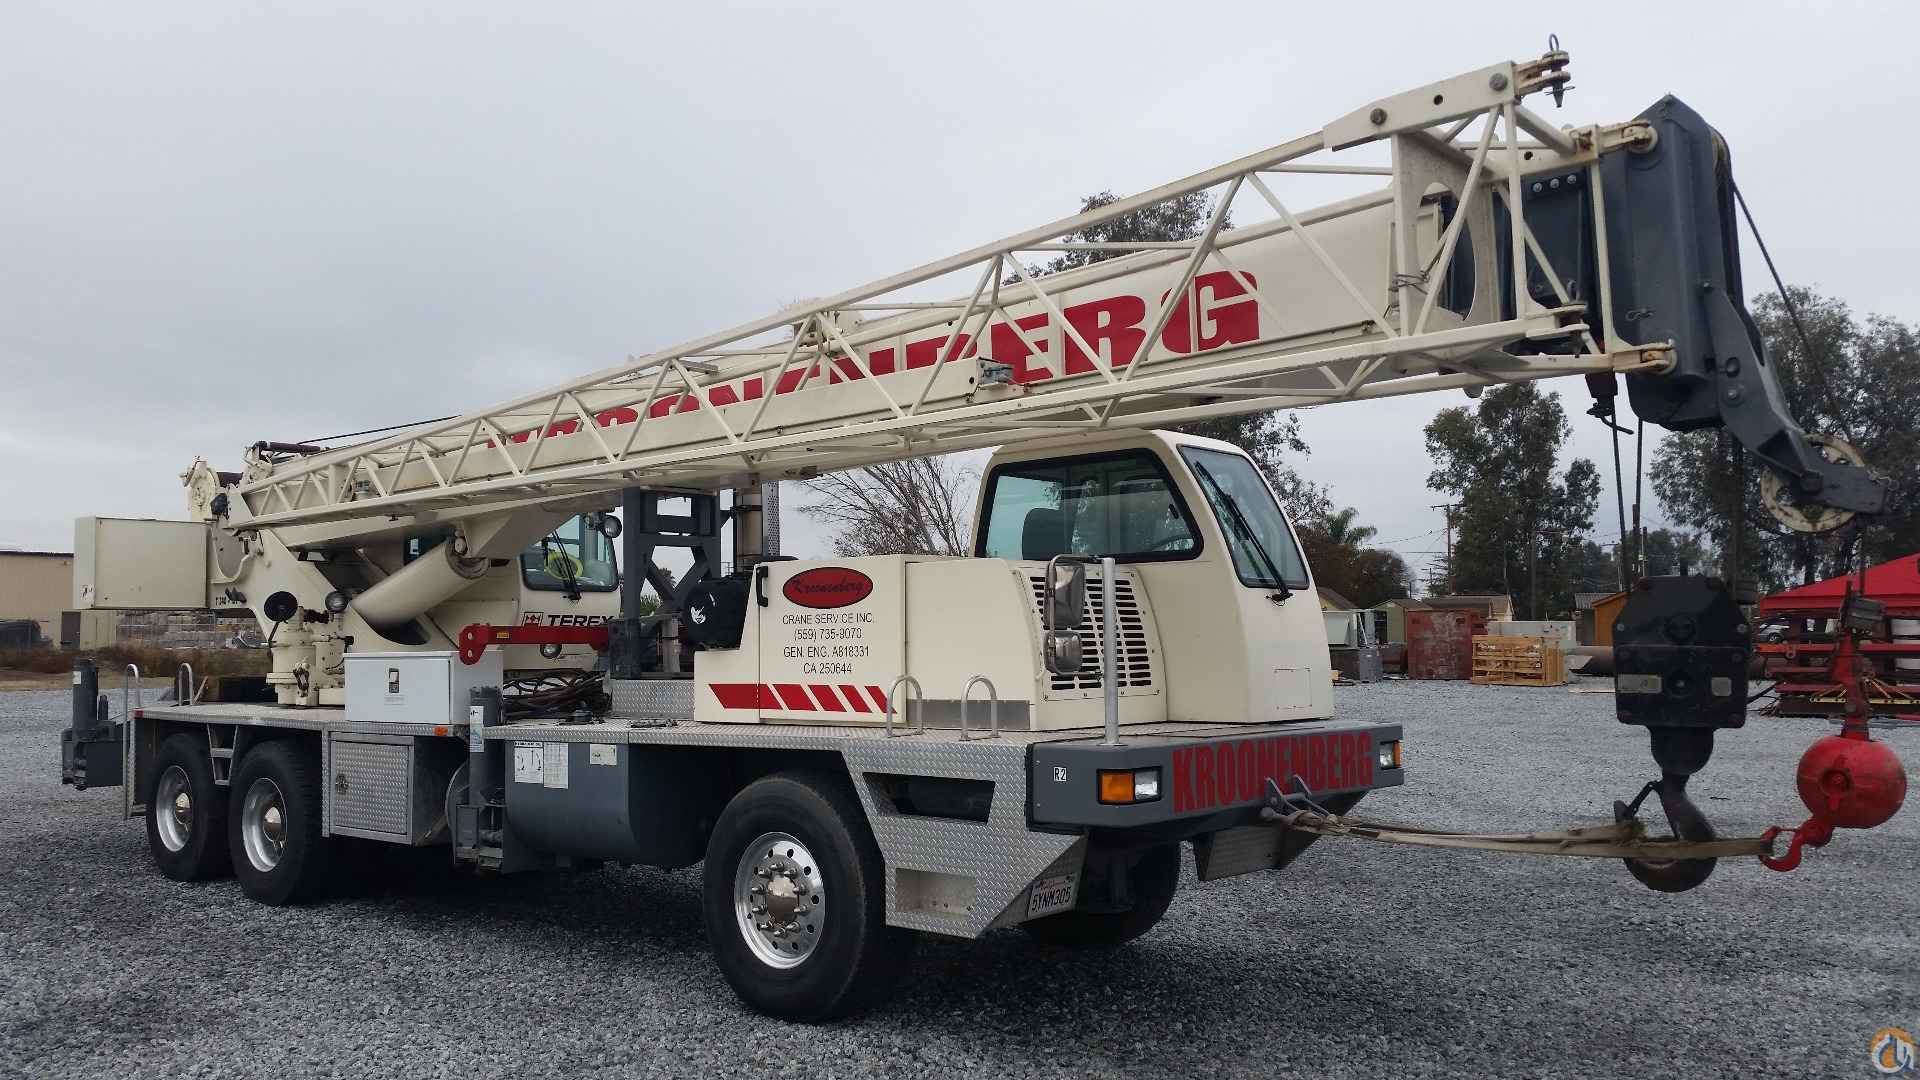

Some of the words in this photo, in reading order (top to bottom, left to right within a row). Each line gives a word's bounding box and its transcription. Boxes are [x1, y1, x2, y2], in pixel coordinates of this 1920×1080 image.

[548, 614, 615, 627] TEREX
[782, 614, 812, 625] CRANE
[814, 613, 853, 624] SERVCE
[794, 628, 817, 642] (559)
[783, 646, 804, 658] GEN.
[807, 645, 830, 658] ENG.
[803, 662, 817, 674] CA
[819, 662, 852, 674] 250644
[1054, 767, 1066, 781] R2
[1171, 731, 1374, 814] KROONENBERG
